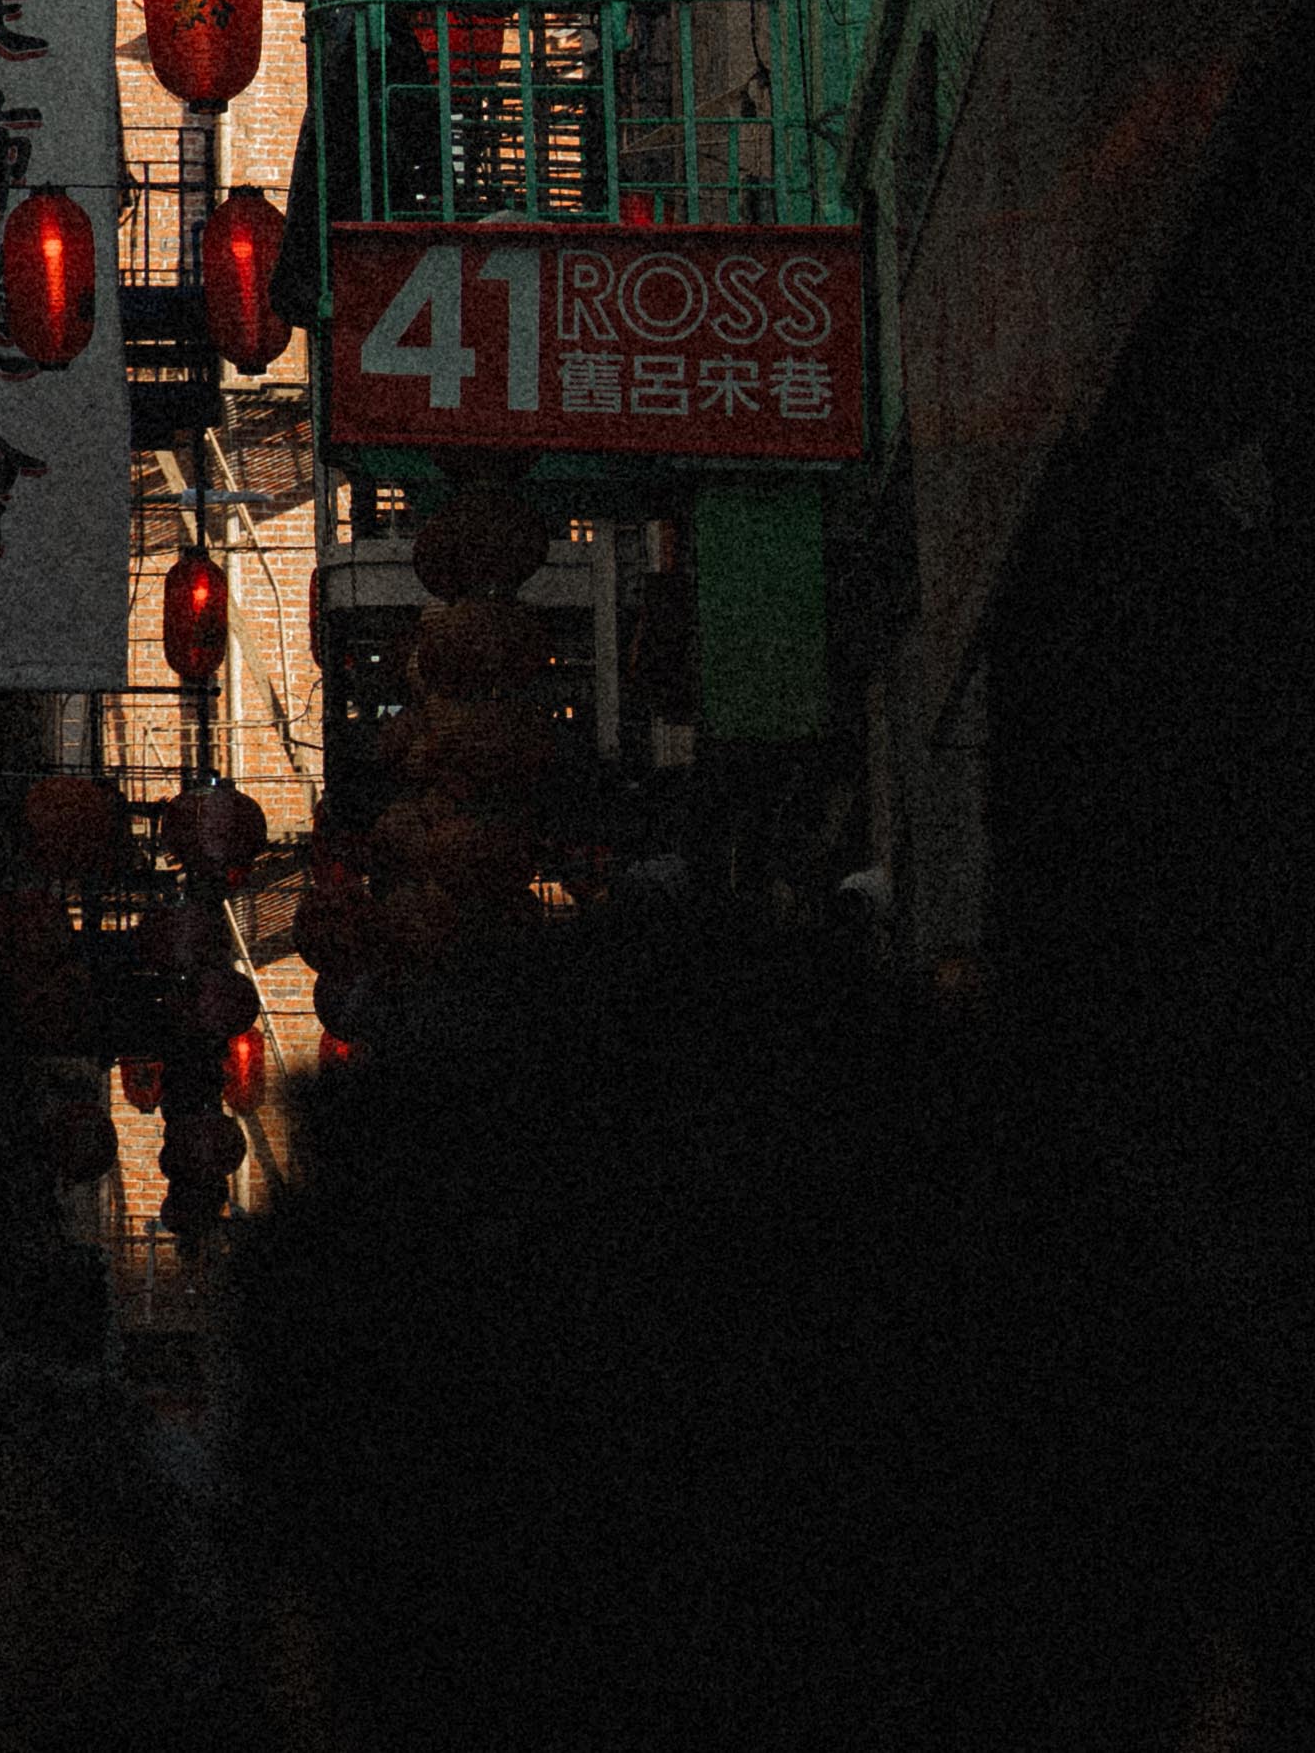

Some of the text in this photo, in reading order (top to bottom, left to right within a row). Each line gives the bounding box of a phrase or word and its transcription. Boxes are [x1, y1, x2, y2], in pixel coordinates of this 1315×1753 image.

[360, 244, 833, 412] 41 ROSS
[556, 350, 834, 421] 舊呂宋巷
